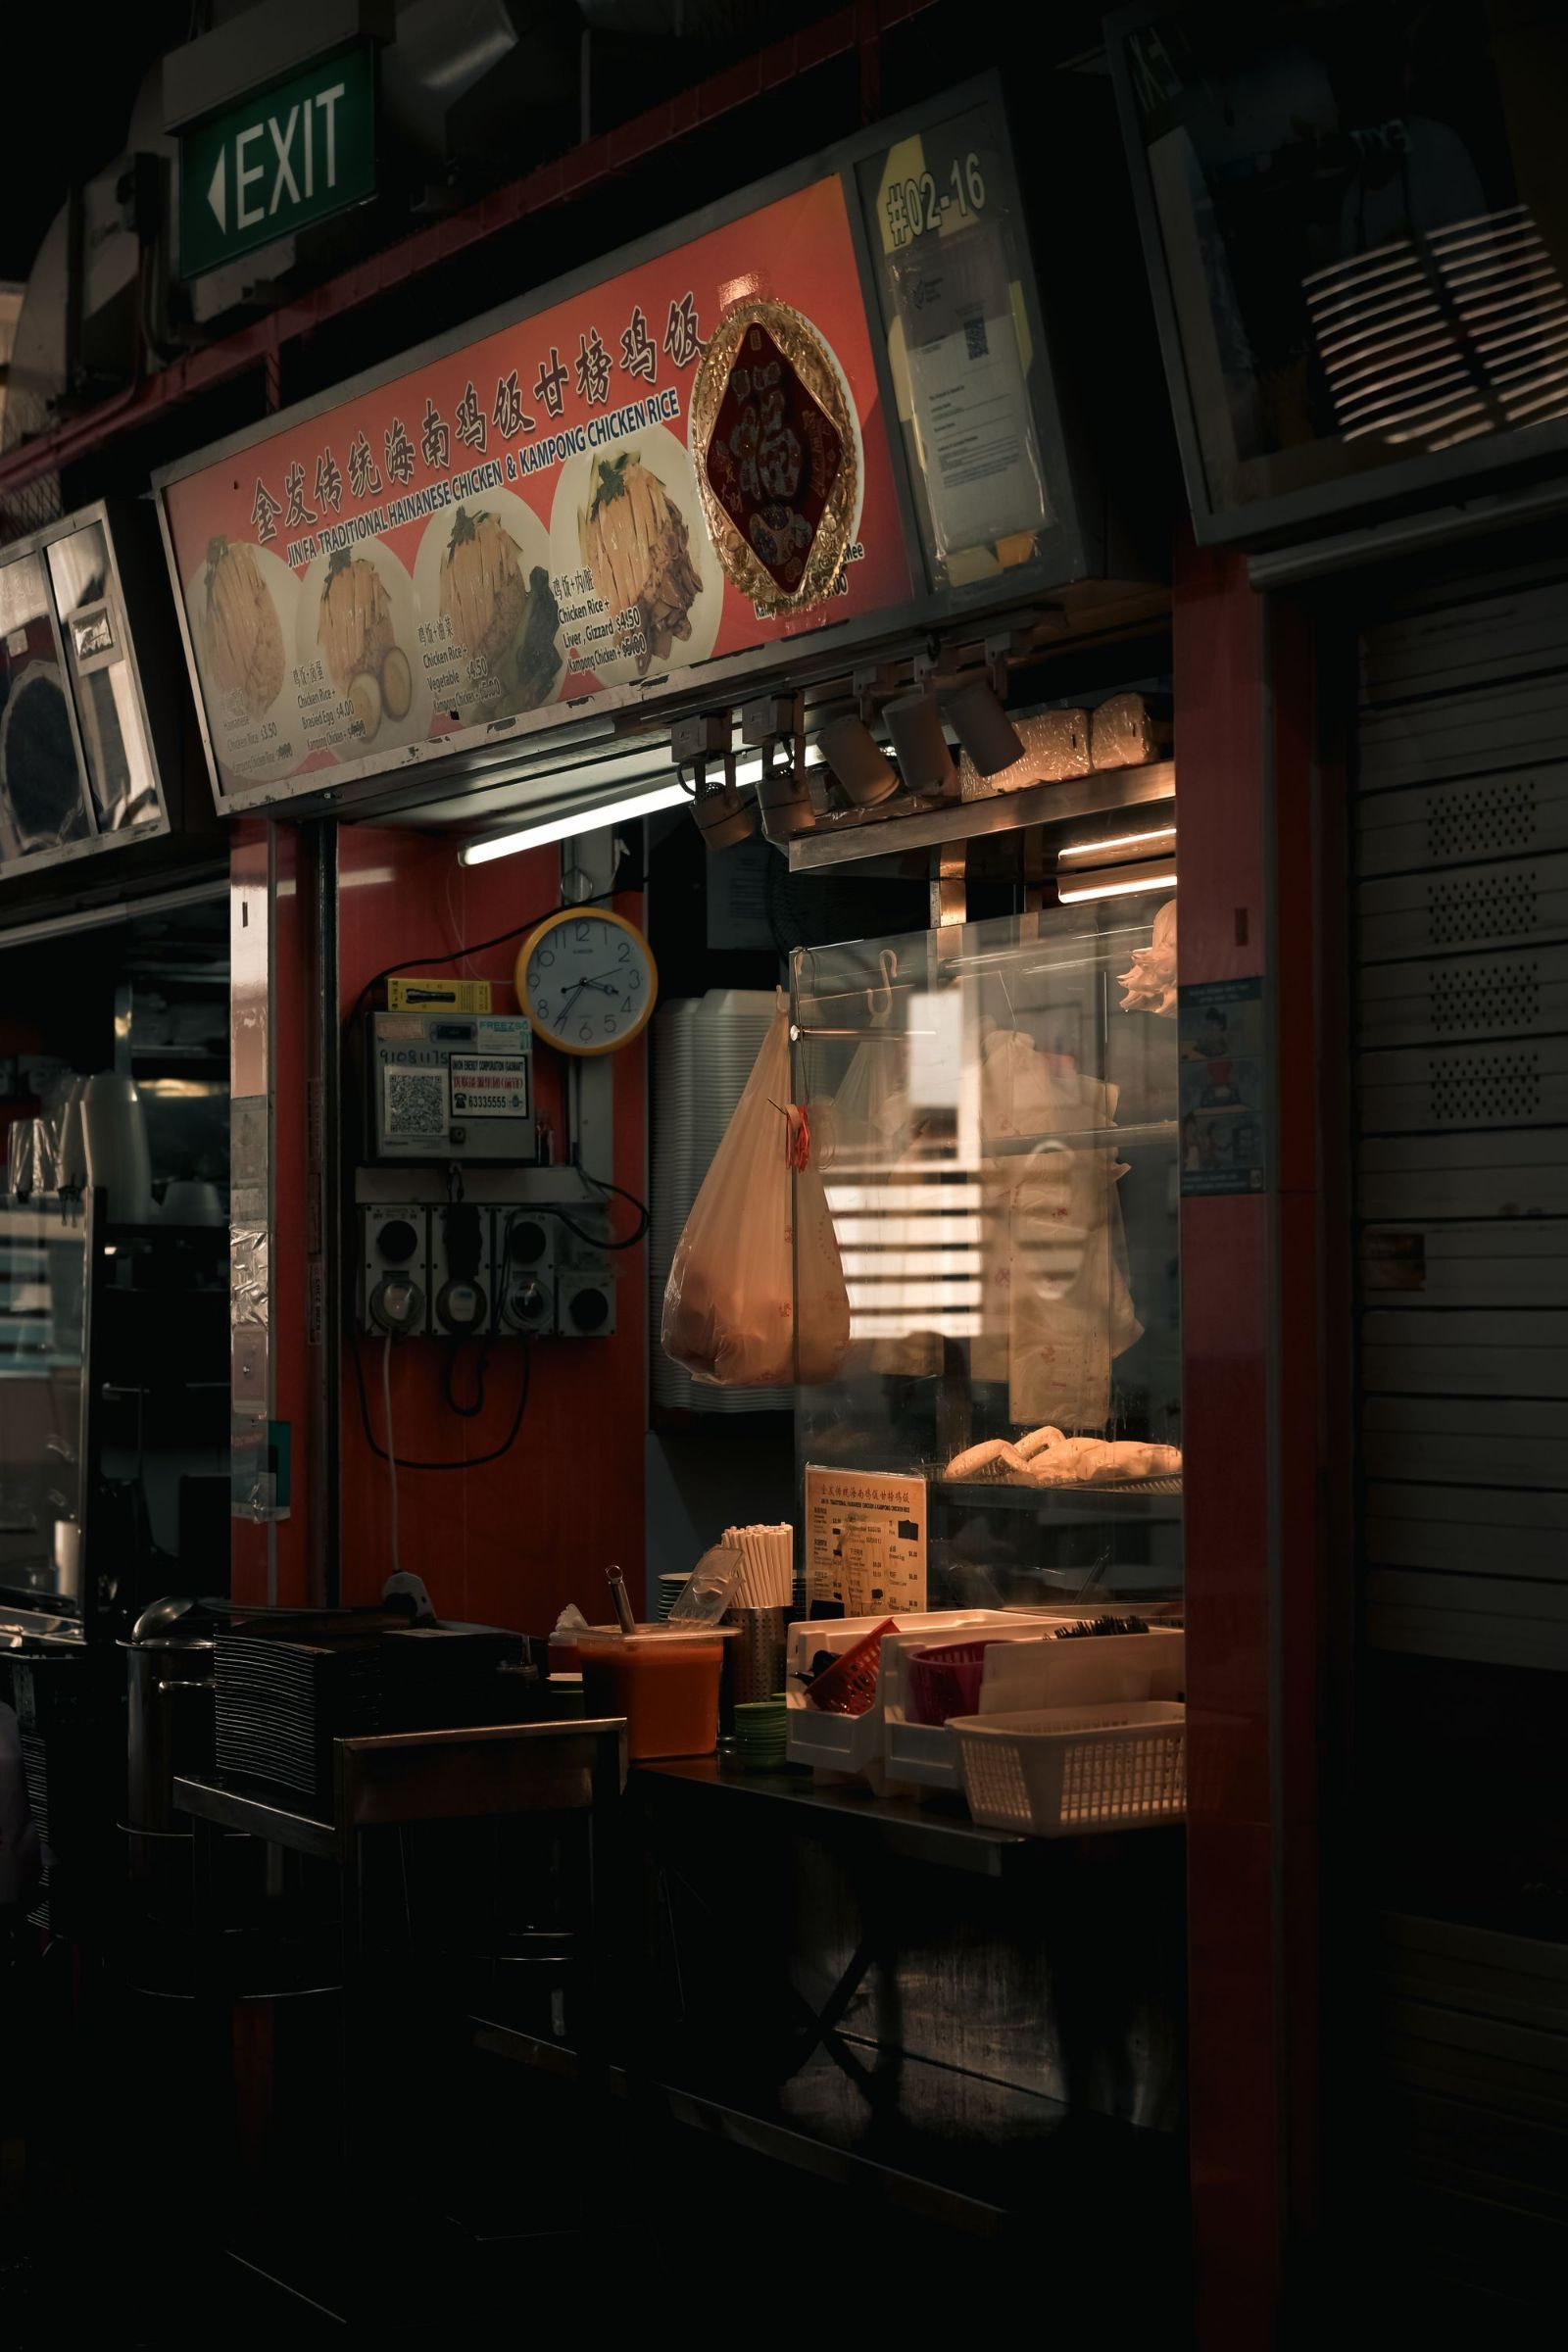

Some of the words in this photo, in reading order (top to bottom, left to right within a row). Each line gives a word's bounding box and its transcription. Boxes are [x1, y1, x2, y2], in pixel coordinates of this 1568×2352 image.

[236, 82, 345, 229] EXIT
[887, 151, 986, 247] #02-16
[287, 544, 303, 568] JIN
[304, 538, 317, 562] FA
[318, 508, 388, 557] TRADITIONAL
[388, 480, 451, 525] HAINANESE
[452, 461, 503, 501] CHICKEN
[507, 456, 516, 480] &
[519, 428, 586, 474] KAMPONG
[588, 404, 646, 447] CHICKEN
[648, 389, 679, 424] RICE
[559, 604, 587, 624] Chicken
[587, 598, 603, 614] Rice
[563, 629, 581, 648] Liver
[586, 618, 613, 642] Gizzard
[422, 649, 448, 668] Chicken
[447, 646, 463, 661] Rice
[567, 655, 595, 674] Kampong
[594, 647, 617, 665] Chicken
[427, 671, 460, 693] Vegetable
[466, 658, 488, 680] $4.50
[297, 691, 319, 709] Chicken
[319, 688, 332, 701] Rice
[321, 710, 334, 726] Egg
[336, 700, 355, 719] $4.00
[261, 721, 277, 740] $3.50
[554, 930, 566, 950] 11
[575, 919, 590, 942] 12
[617, 942, 630, 963] 2
[527, 973, 540, 993] 9
[628, 969, 641, 990] 3
[537, 999, 549, 1020] 8
[620, 995, 632, 1013] 4
[579, 1021, 593, 1041] 6
[604, 1013, 616, 1033] 5
[468, 1095, 506, 1108] 63335555
